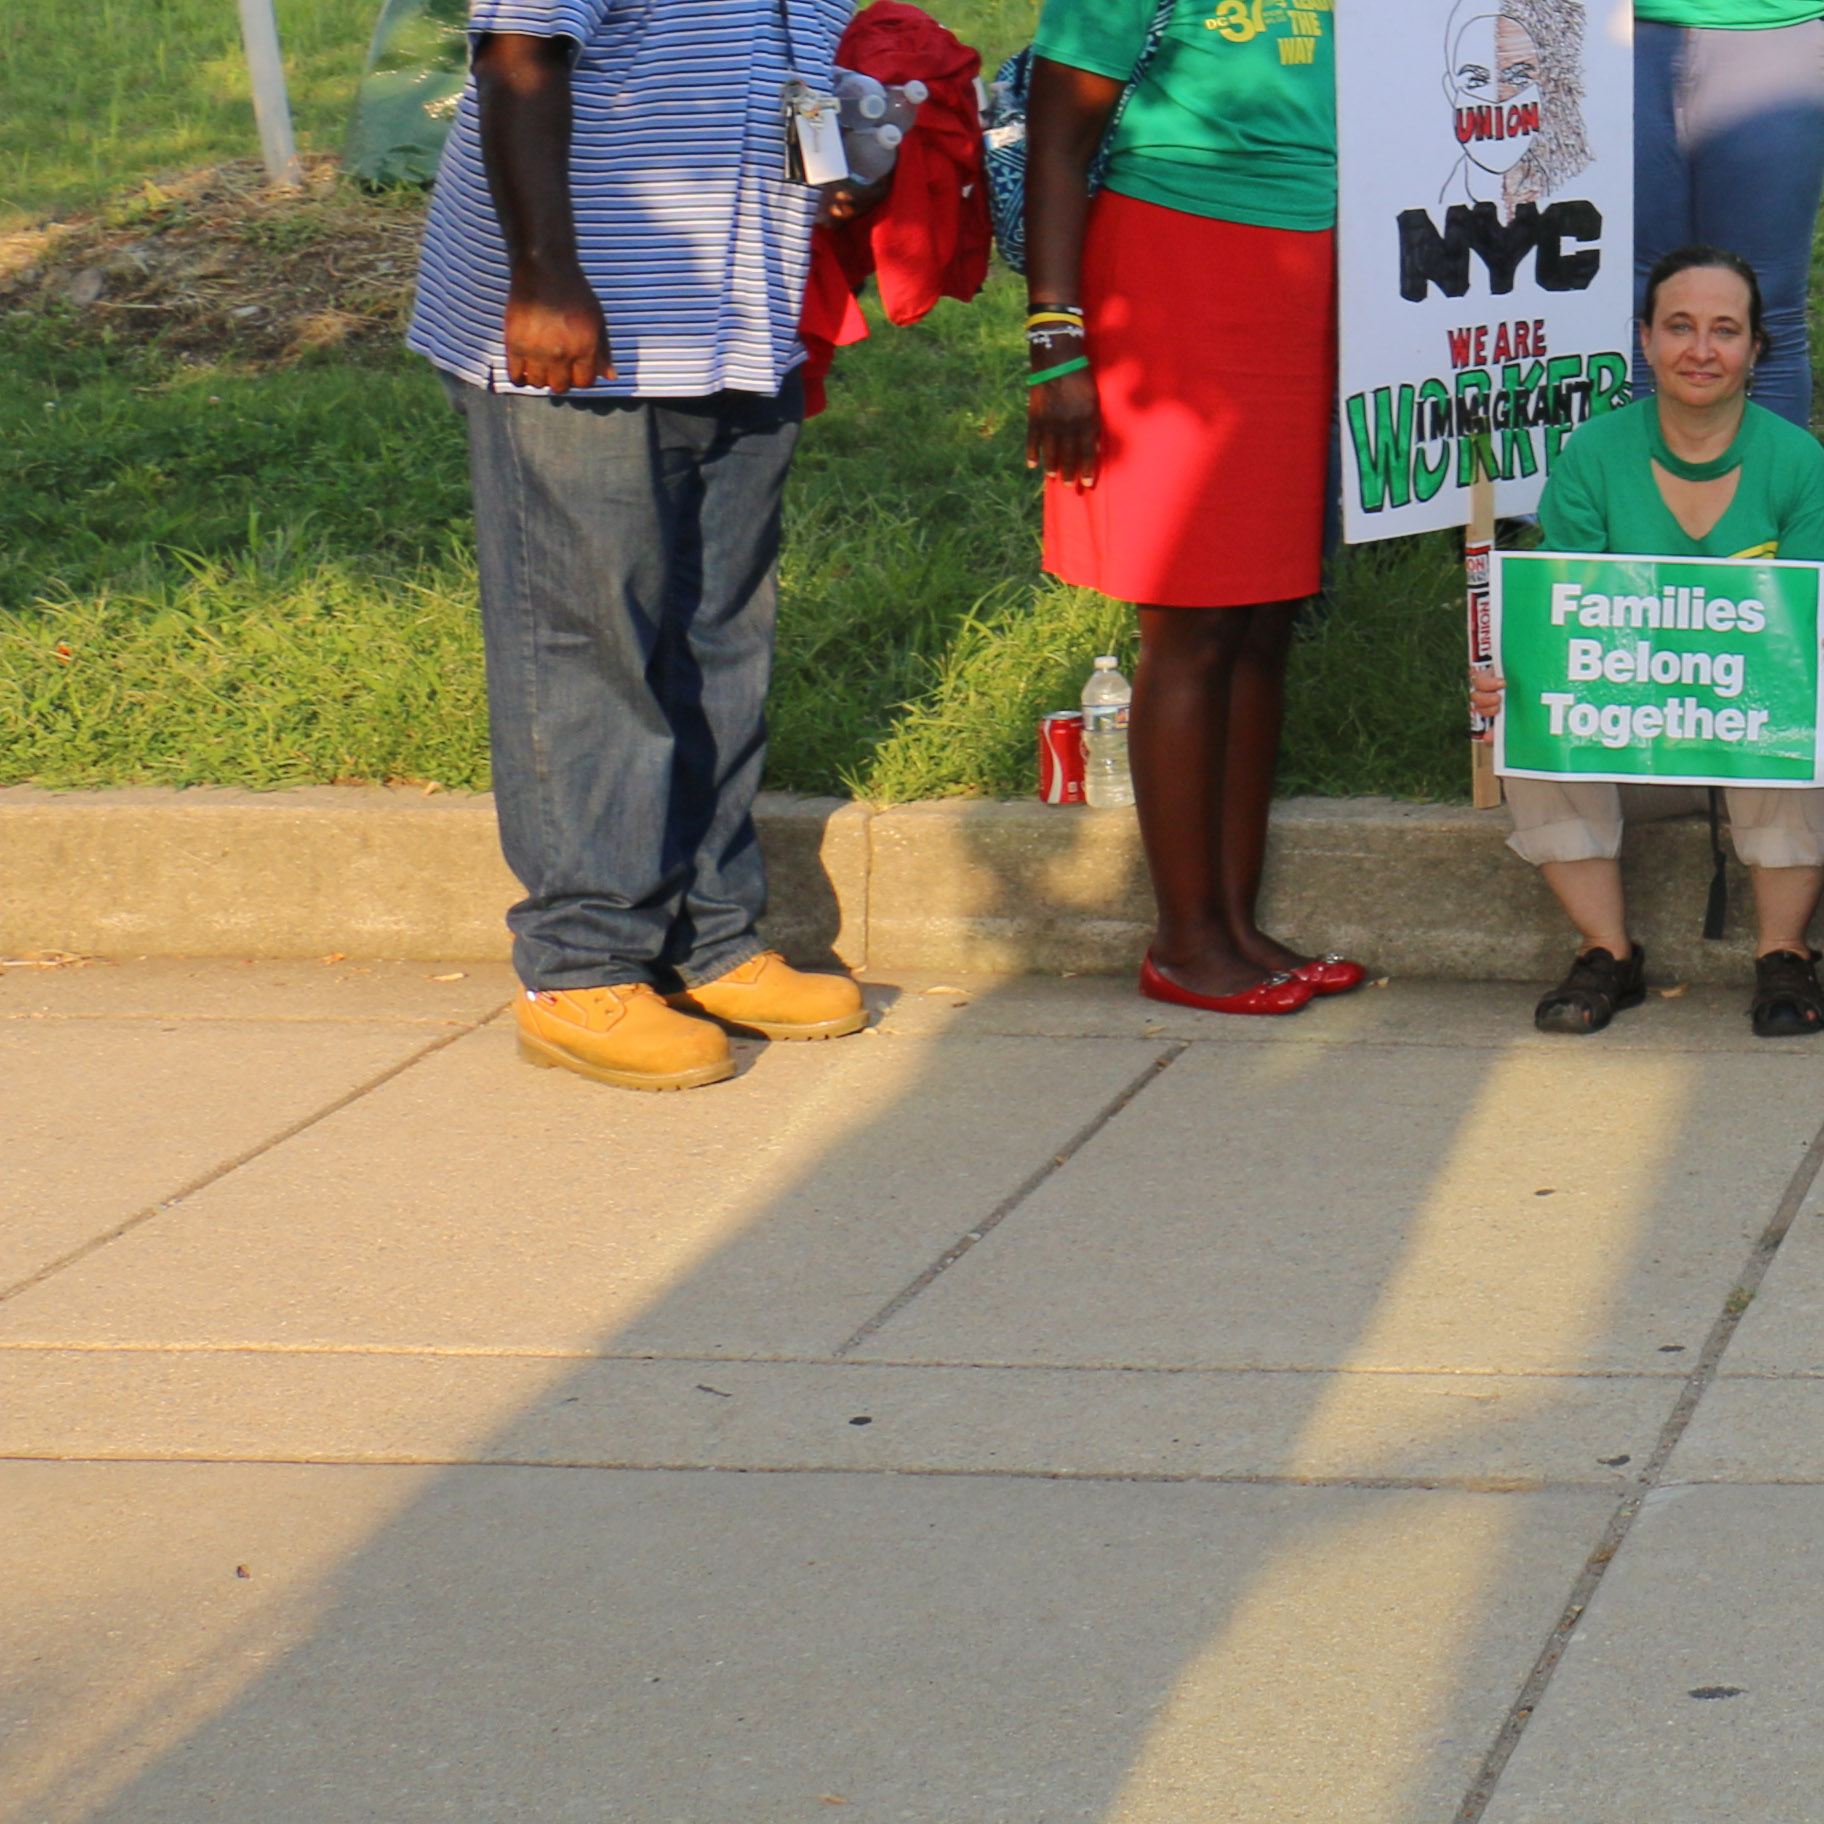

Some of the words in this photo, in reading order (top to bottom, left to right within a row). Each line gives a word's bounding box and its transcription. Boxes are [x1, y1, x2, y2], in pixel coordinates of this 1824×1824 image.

[1454, 101, 1540, 143] UNION
[1396, 199, 1602, 303] NYC
[1447, 324, 1489, 369] WE
[1492, 319, 1547, 365] ARE
[1479, 600, 1492, 653] UNION
[1550, 582, 1768, 634] Families
[1567, 638, 1745, 699] Belong
[1541, 692, 1772, 748] Together
